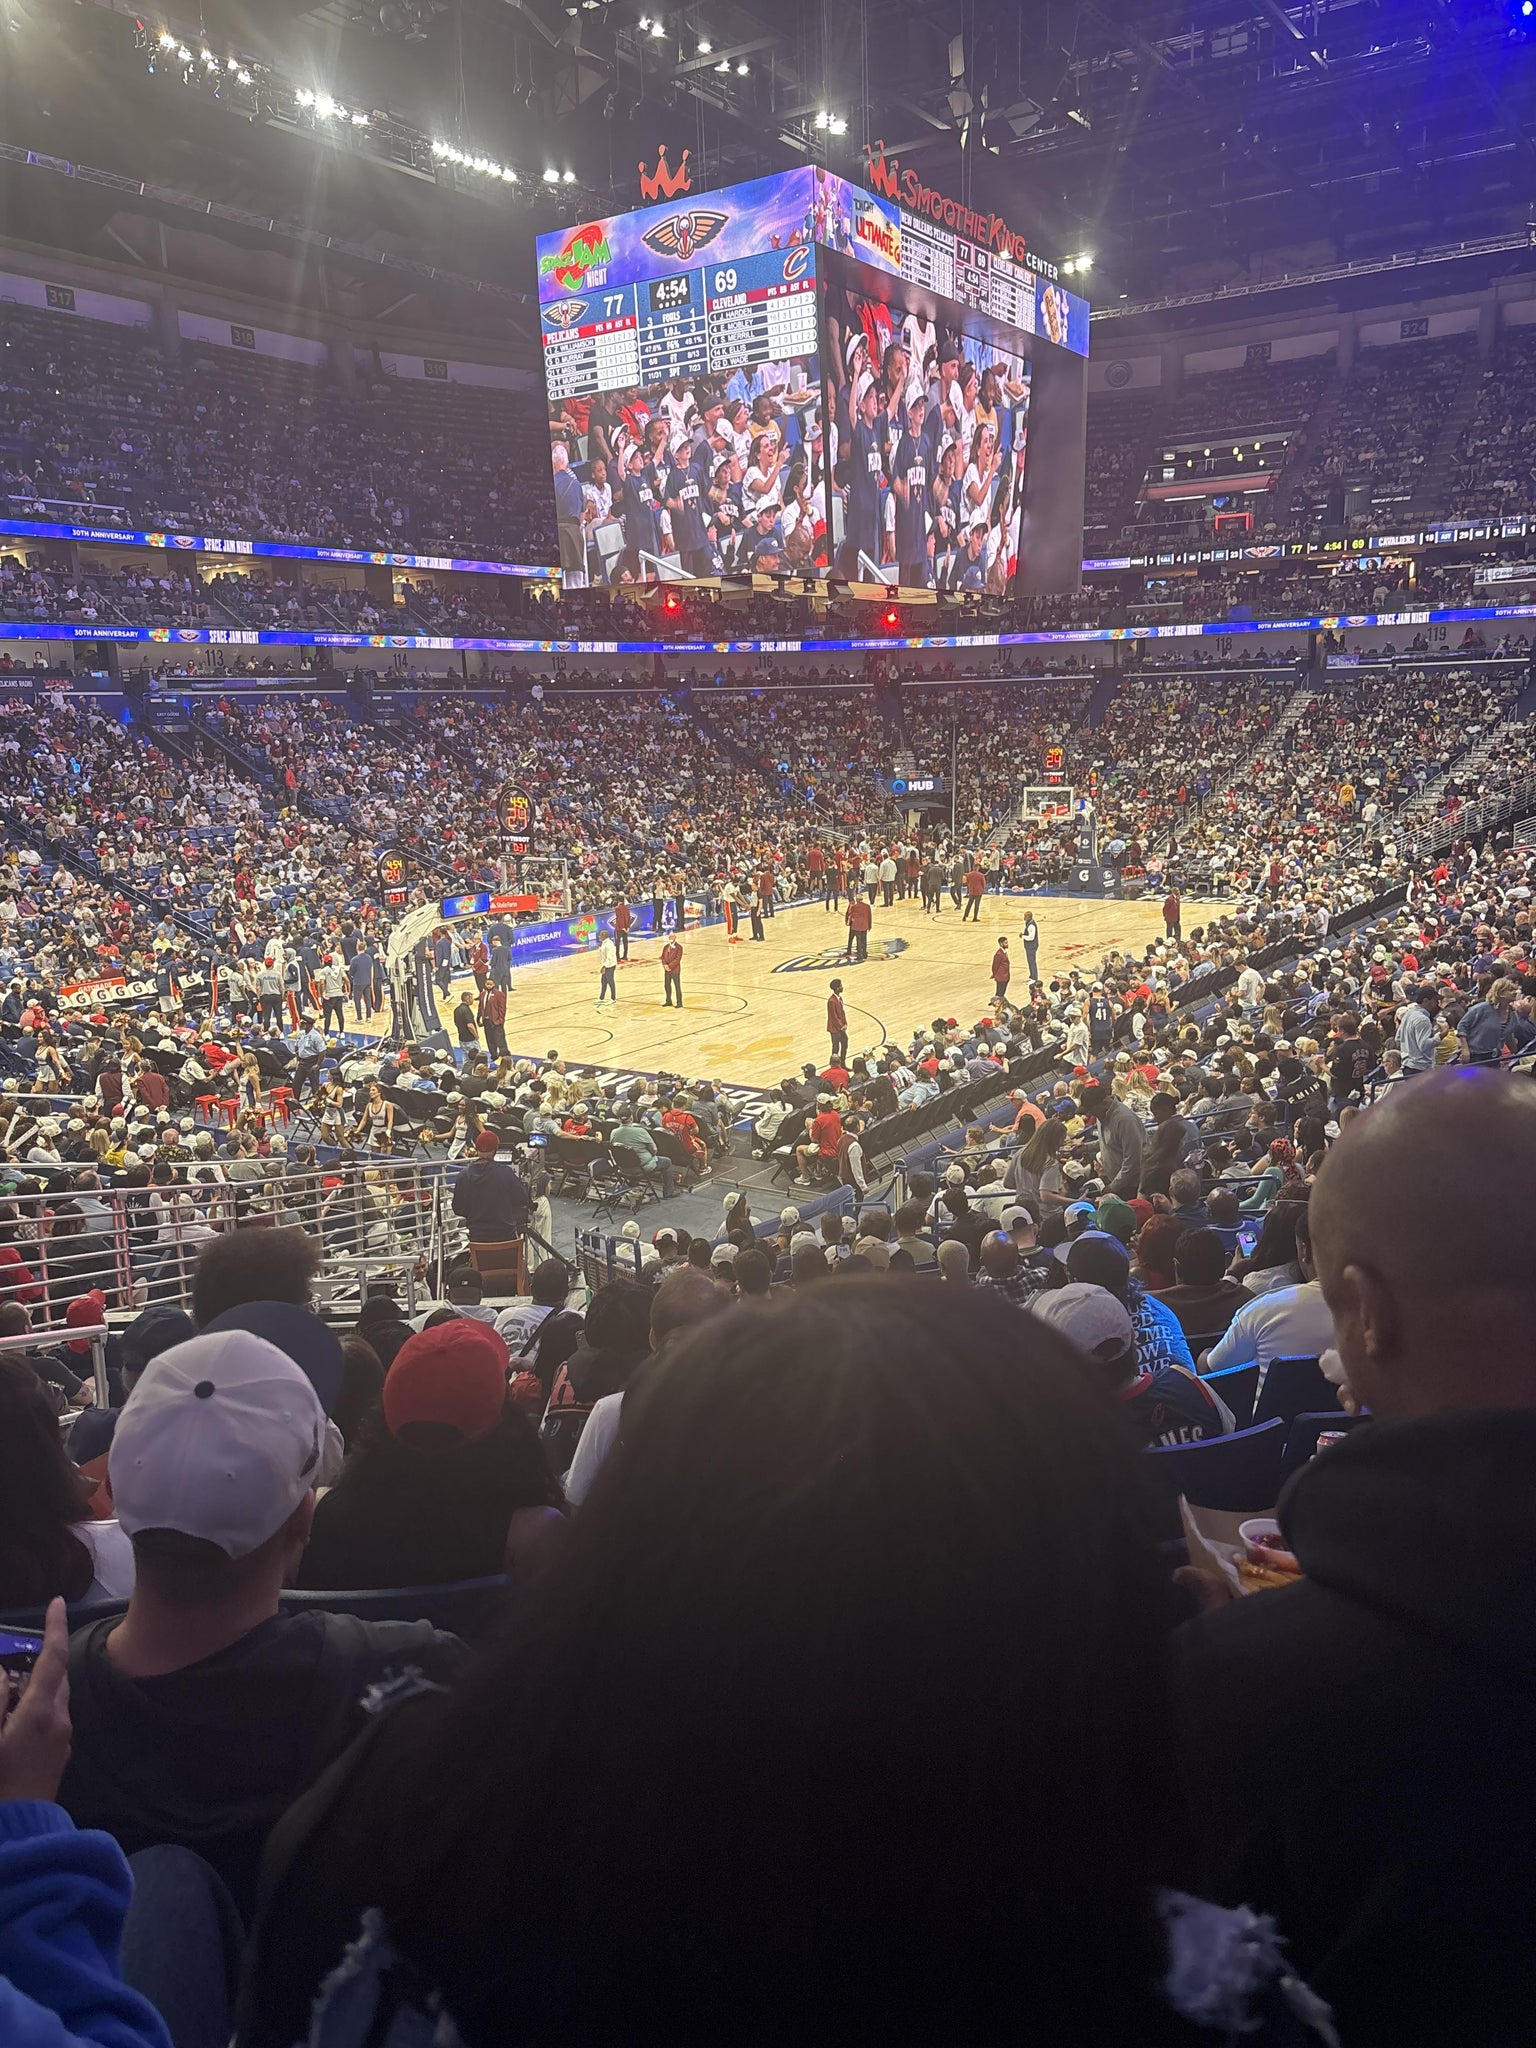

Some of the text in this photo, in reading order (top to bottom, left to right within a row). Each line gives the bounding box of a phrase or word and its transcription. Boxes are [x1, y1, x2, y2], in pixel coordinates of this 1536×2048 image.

[855, 215, 894, 256] ULTIMATE
[960, 244, 968, 259] 77
[1026, 252, 1058, 280] CENTER
[586, 268, 607, 288] NIGHT
[714, 268, 738, 292] 69
[656, 278, 688, 300] 4:54
[49, 289, 72, 306] 317
[712, 293, 747, 310] CLEVELAND
[603, 293, 624, 317] 77
[662, 311, 680, 322] FOULS
[1402, 321, 1427, 335] 324
[546, 327, 580, 344] PELICANS
[670, 354, 678, 363] FT
[72, 529, 134, 541] 30TH ANNIVERSARY
[1378, 535, 1415, 546] CAVALIERS
[204, 537, 253, 554] SPACE JAM NIGHT
[1291, 545, 1302, 554] 77
[1324, 542, 1342, 550] 4:54
[1352, 540, 1364, 549] 69
[330, 552, 363, 560] ANNIVERSARY
[1377, 612, 1430, 625] SPACE JAM NIGHT
[74, 629, 138, 638] 30TH ANNIVERSARY
[209, 630, 260, 644] SPACE JAM NIGHT
[1158, 625, 1202, 637] SPACE JAM NIGHT
[1427, 626, 1446, 642] 119
[1215, 638, 1232, 652] 118
[205, 650, 224, 666] 113
[393, 654, 408, 668] 114
[552, 656, 566, 670] 115
[758, 655, 773, 668] 116
[1046, 756, 1062, 768] 24
[908, 780, 934, 791] HUB
[386, 870, 400, 882] 24
[1078, 870, 1089, 882] G
[516, 930, 562, 948] ANNIVERSARY
[1096, 1008, 1106, 1020] 41
[1146, 1326, 1174, 1341] ME
